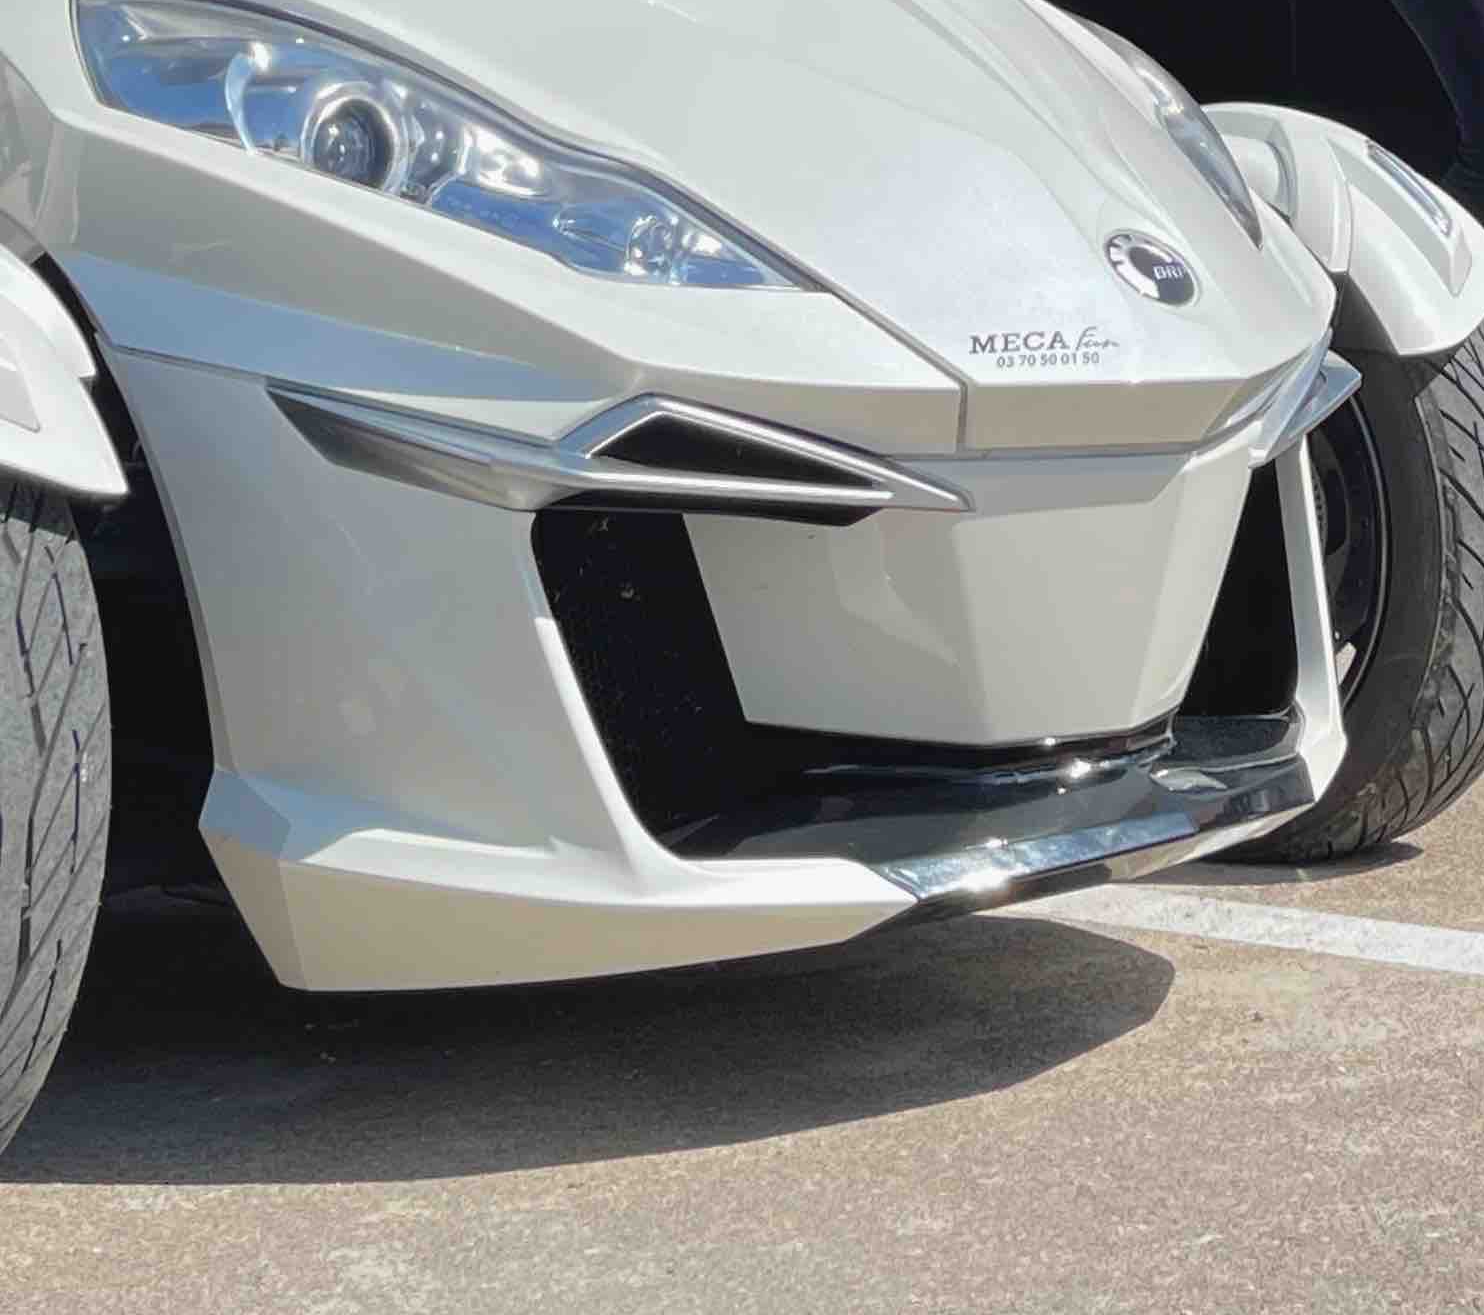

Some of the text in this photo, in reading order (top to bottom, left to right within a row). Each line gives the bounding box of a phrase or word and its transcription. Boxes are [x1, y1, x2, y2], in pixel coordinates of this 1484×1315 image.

[968, 330, 1070, 355] MECA
[996, 351, 1101, 368] 03 70 50 01 50
